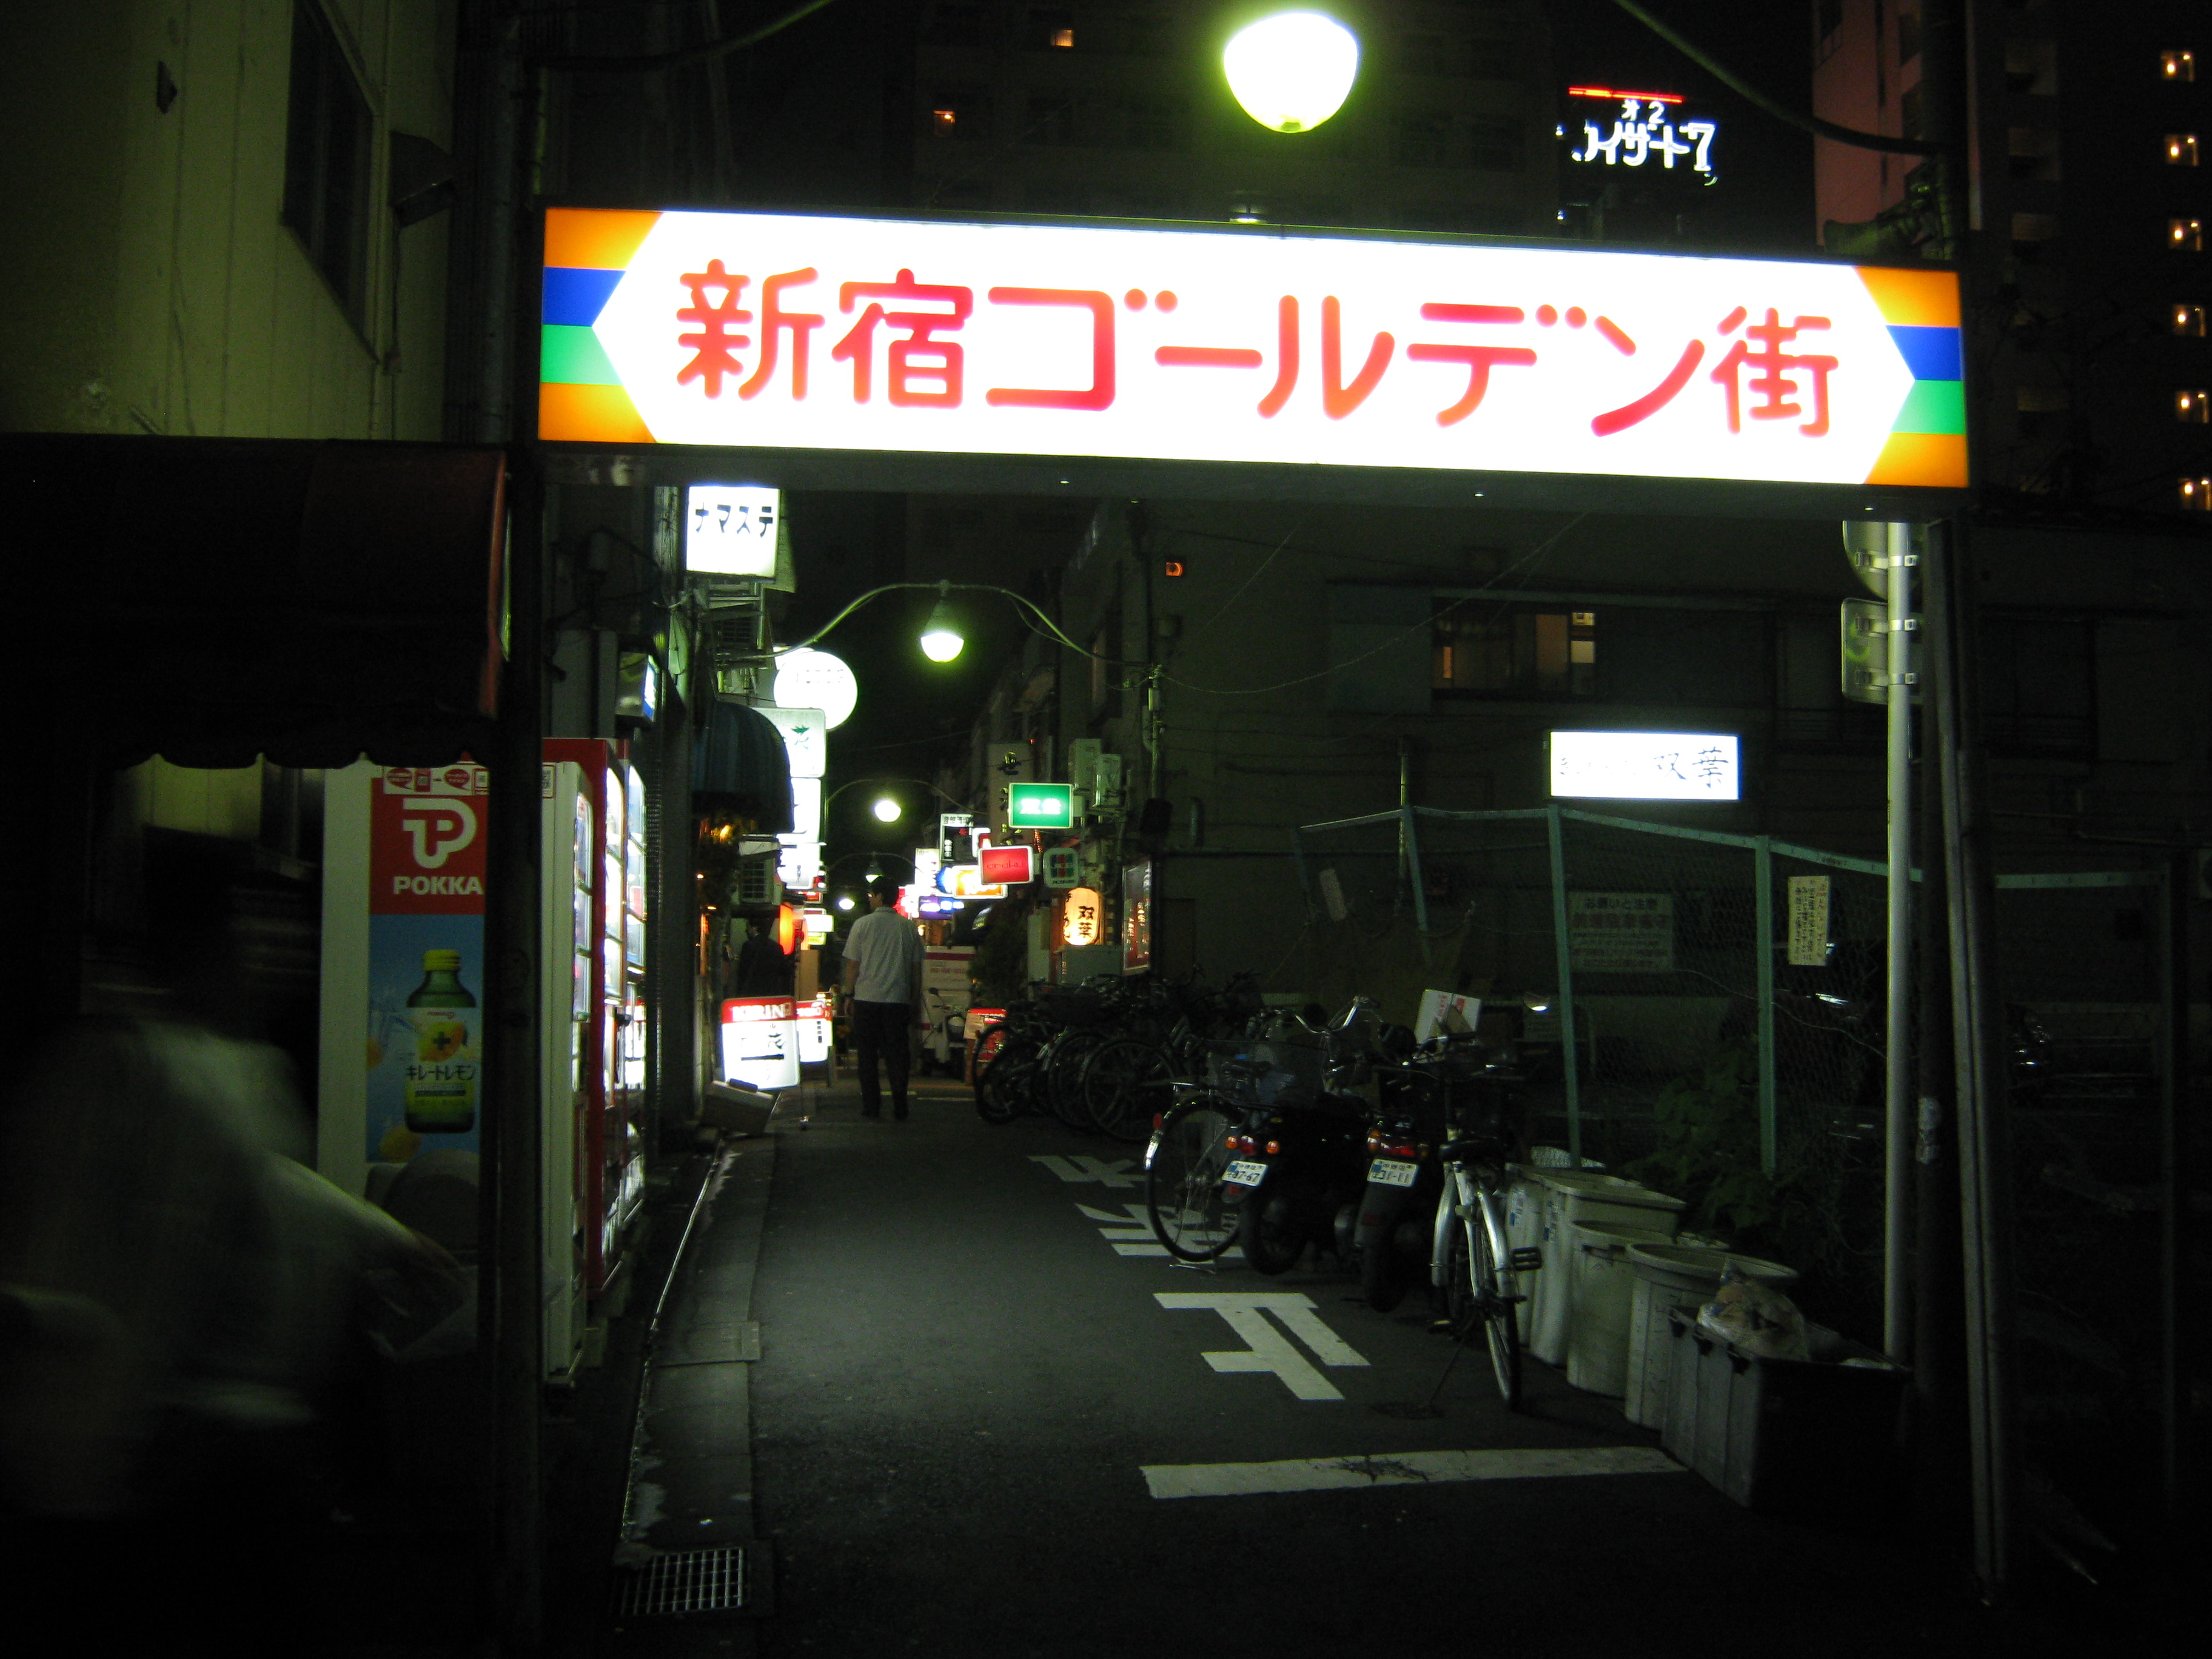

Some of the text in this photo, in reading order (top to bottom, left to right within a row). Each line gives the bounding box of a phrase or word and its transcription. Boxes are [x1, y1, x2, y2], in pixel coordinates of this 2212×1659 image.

[676, 258, 1840, 439] 新宿ゴールデン街
[695, 501, 774, 538] ナマステ
[394, 876, 484, 896] POKKA
[732, 1004, 785, 1022] KIRIN
[406, 1064, 477, 1082] キレートレモン
